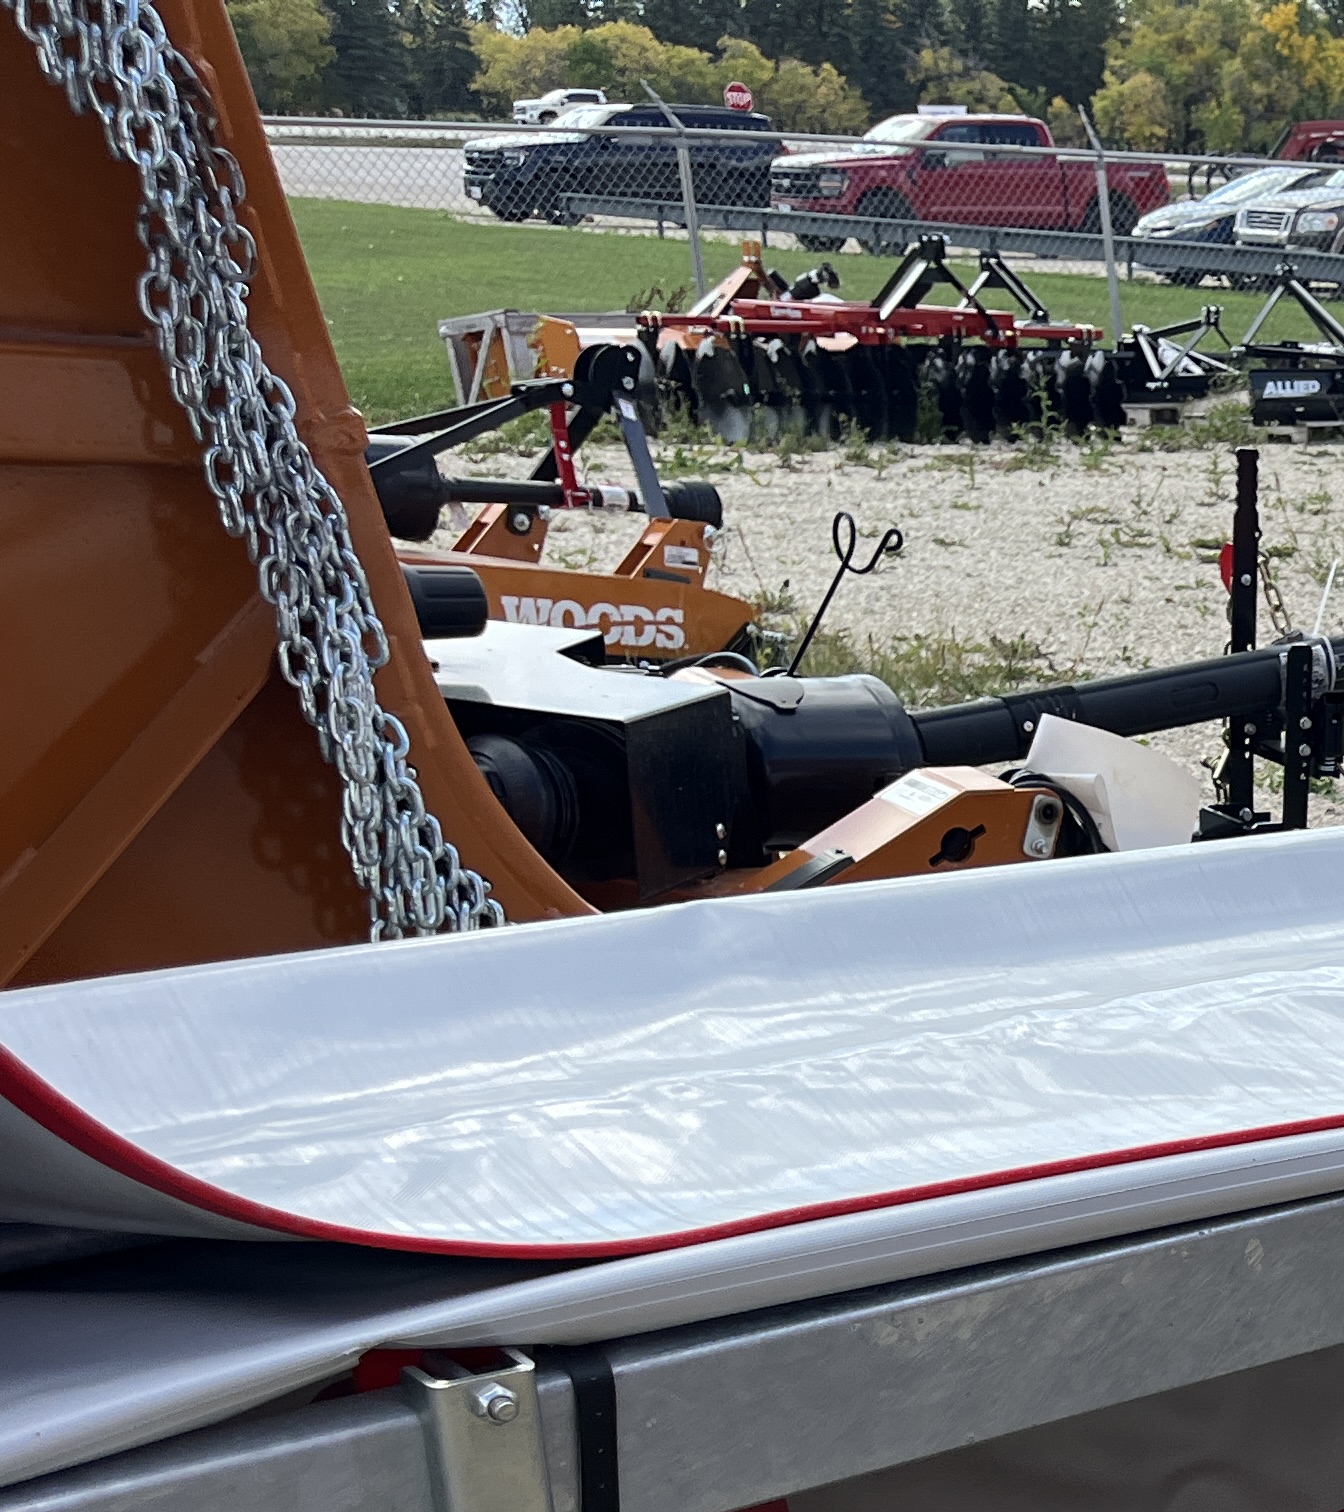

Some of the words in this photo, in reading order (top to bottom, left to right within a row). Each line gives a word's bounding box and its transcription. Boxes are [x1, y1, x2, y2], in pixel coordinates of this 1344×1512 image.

[726, 92, 751, 106] STOP
[1262, 379, 1321, 398] ALLIED
[501, 595, 686, 649] WOODS
